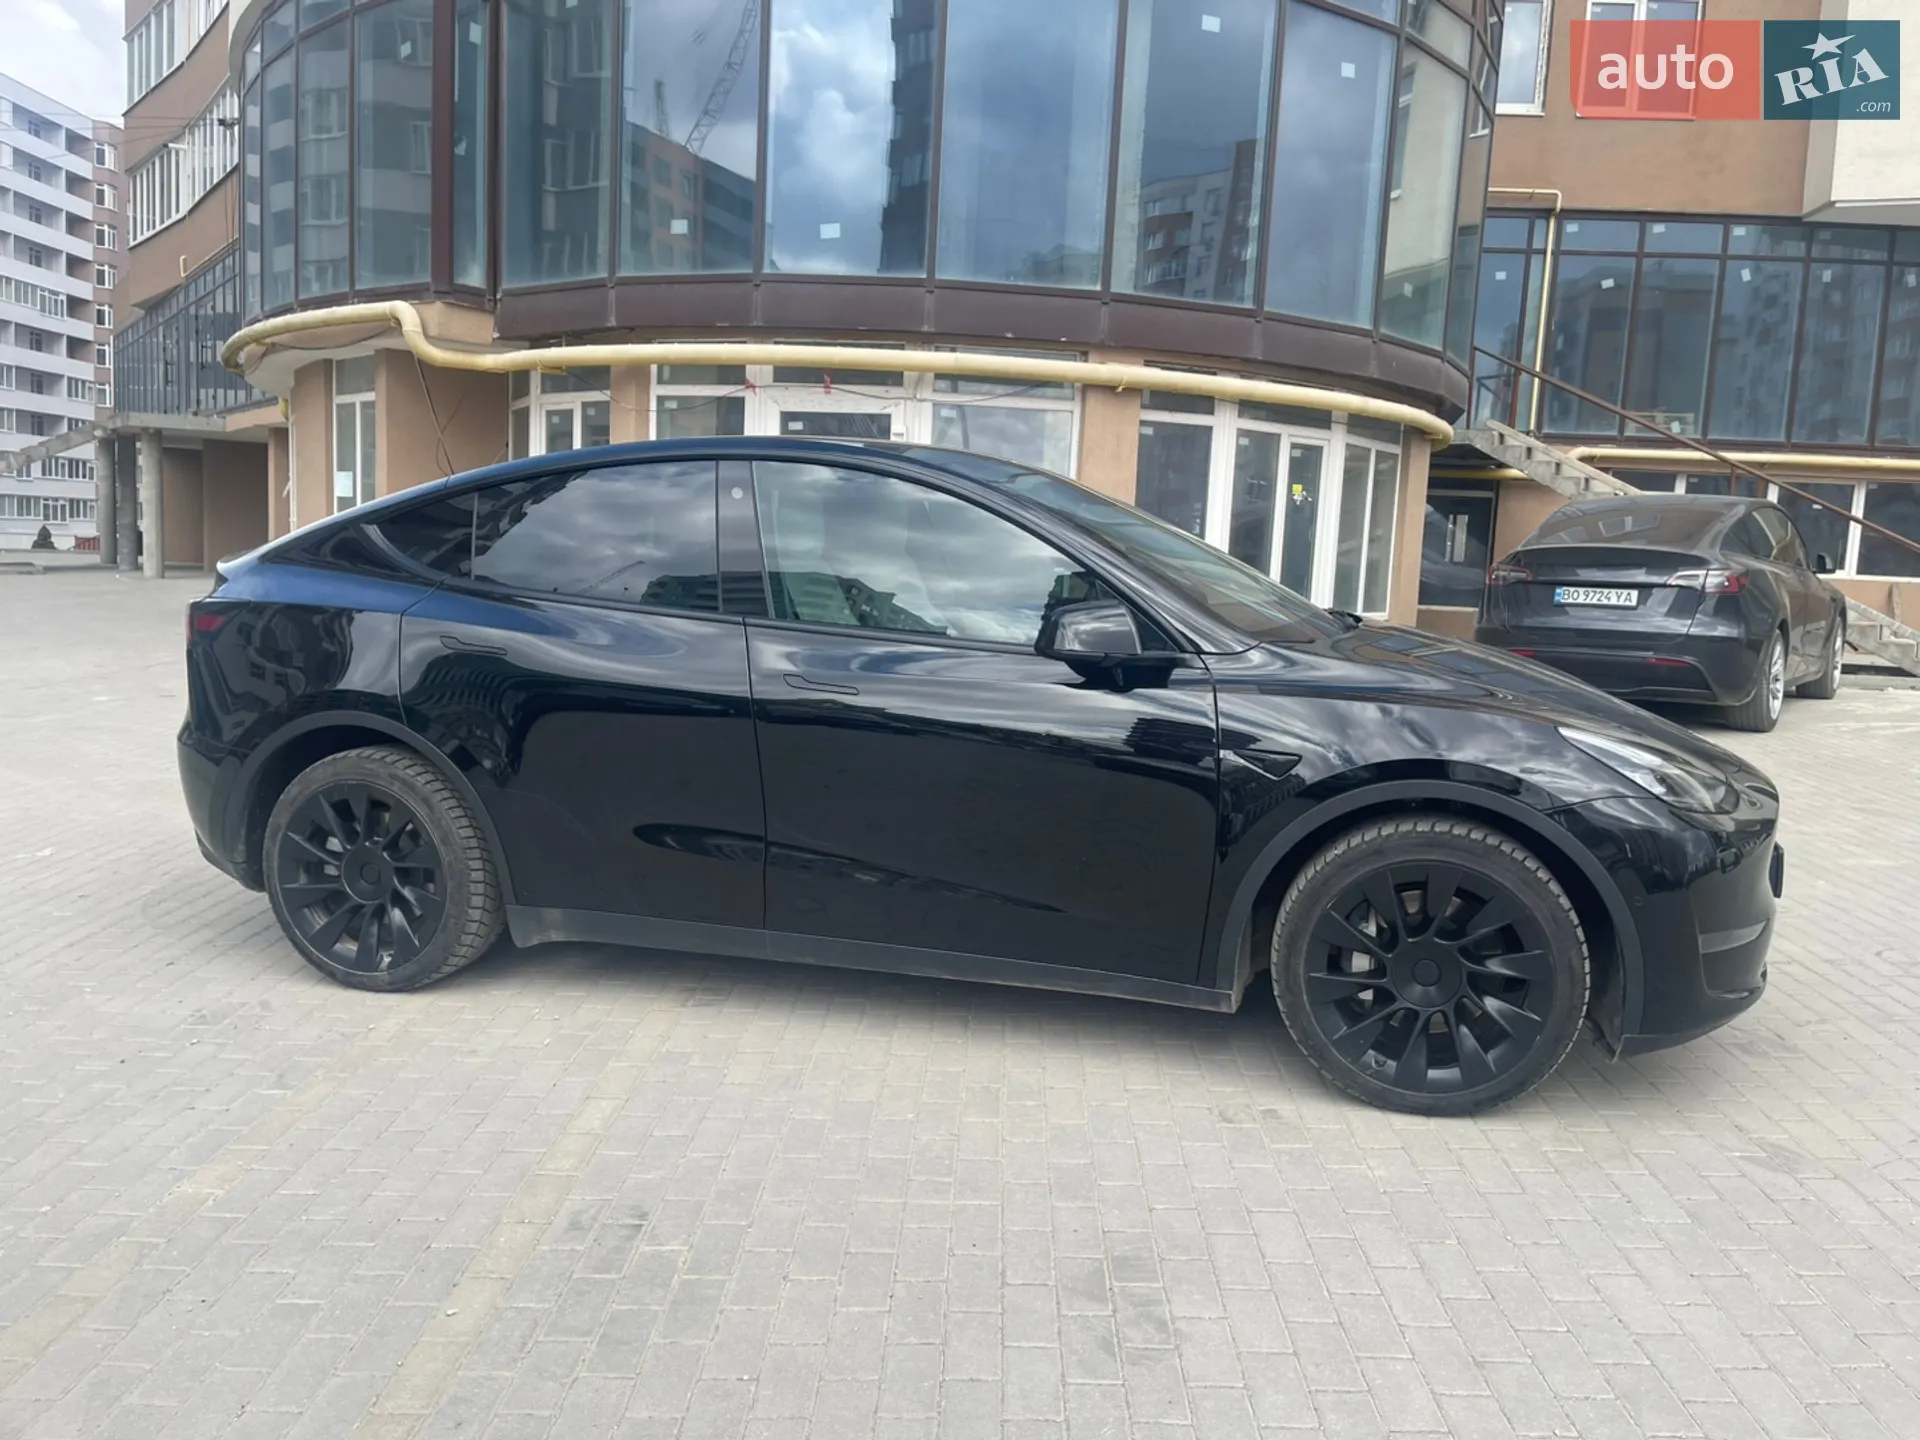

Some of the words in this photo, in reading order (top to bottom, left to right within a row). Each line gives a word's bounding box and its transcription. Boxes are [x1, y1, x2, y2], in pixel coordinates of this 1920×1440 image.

[1562, 589, 1580, 601] BO
[1582, 590, 1612, 603] 9724
[1615, 591, 1632, 604] YA
